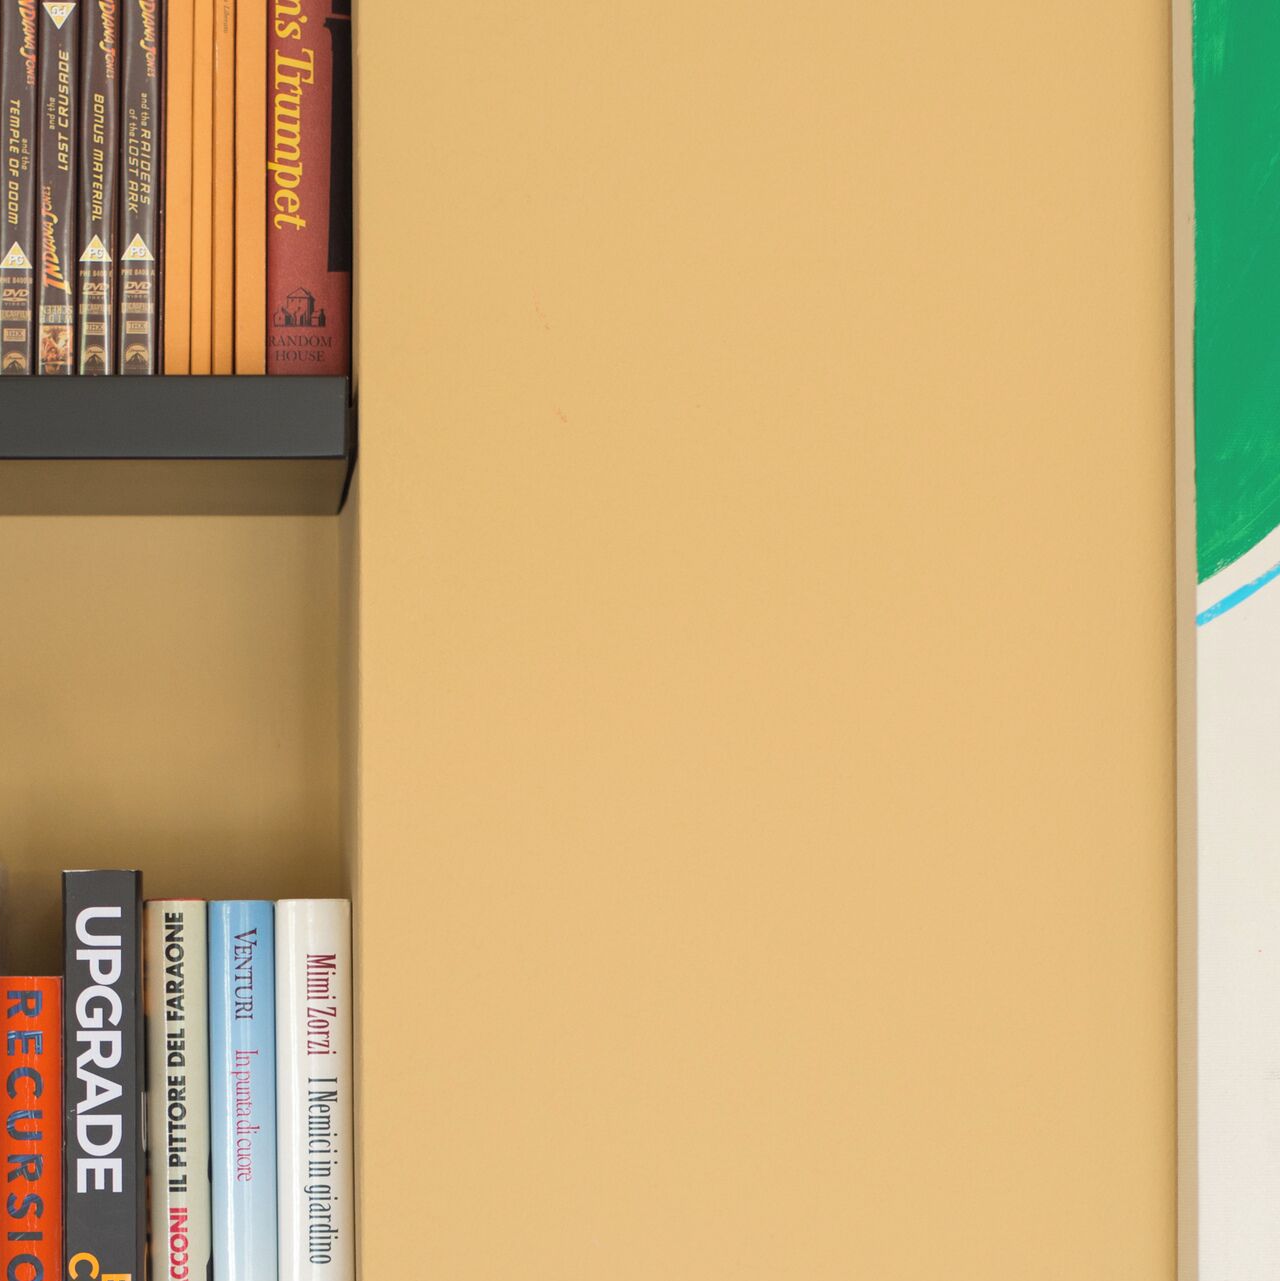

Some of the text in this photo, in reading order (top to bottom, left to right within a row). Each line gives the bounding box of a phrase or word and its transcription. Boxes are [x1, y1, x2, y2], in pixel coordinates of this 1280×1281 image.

[8, 100, 20, 224] TEMPLE OF DOOM
[58, 50, 69, 171] LAST CRUSADE
[92, 94, 104, 221] BONUS MATERIAL
[268, 47, 315, 229] Trumpet
[269, 336, 332, 348] RANDOM
[275, 351, 325, 362] HOUSE
[75, 906, 122, 1193] UPGRADE
[166, 911, 187, 1193] IL PITTORE DEL FARAONE
[306, 954, 336, 1056] Mimi Zorzi
